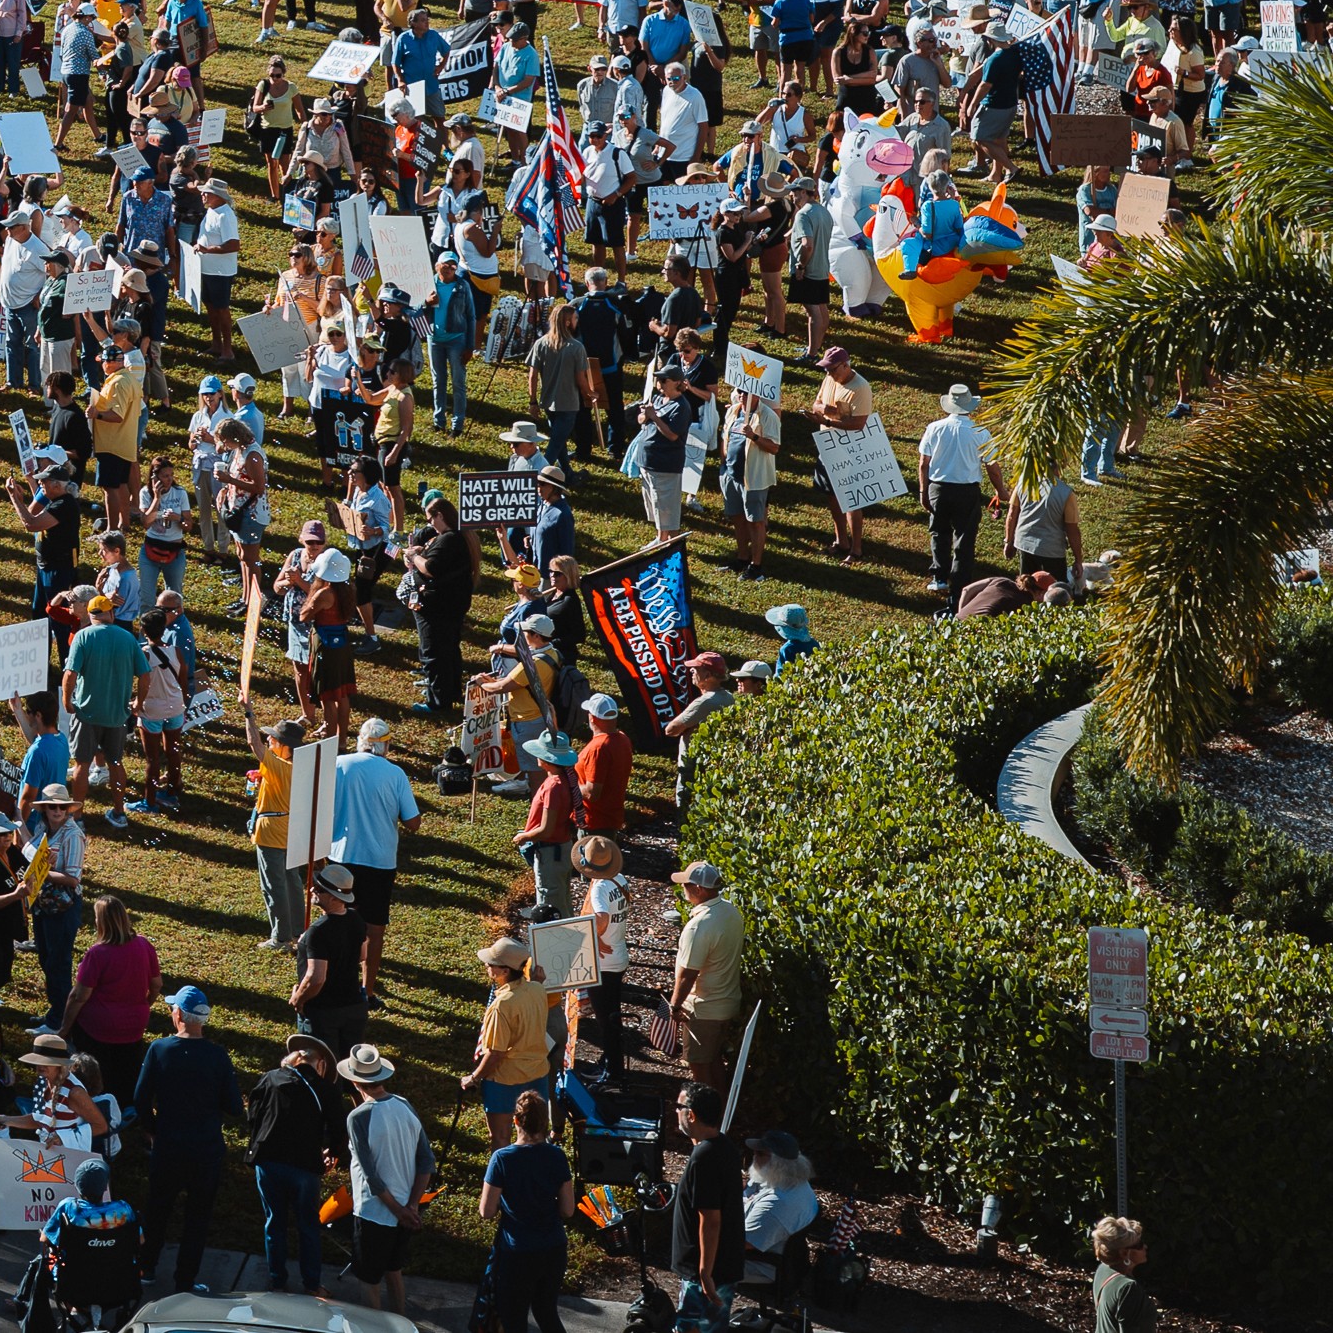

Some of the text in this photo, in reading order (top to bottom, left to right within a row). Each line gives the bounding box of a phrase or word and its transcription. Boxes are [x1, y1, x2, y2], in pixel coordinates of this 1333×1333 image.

[1262, 4, 1293, 23] NO KINGS
[940, 18, 957, 28] NO
[937, 31, 952, 41] NO
[1266, 24, 1295, 39] IMPEACH
[701, 183, 724, 194] ONLY
[1119, 213, 1140, 226] KING
[379, 229, 397, 243] NO
[651, 228, 686, 240] ORANGE
[391, 245, 413, 257] KING
[384, 263, 431, 279] IMPEACH
[77, 275, 89, 286] So
[68, 289, 84, 298] even
[73, 297, 84, 306] are
[728, 369, 777, 400] NO KINGS
[820, 416, 882, 452] HERE
[847, 443, 863, 455] I'M
[830, 448, 889, 474] THAT'S WHY
[835, 463, 894, 488] MY COUNTRY
[462, 478, 536, 493] HATE WILL
[462, 493, 536, 508] NOT MAKE
[847, 485, 886, 509] LOVE
[462, 506, 534, 522] US GREAT
[608, 585, 661, 687] ARE PISSED
[466, 710, 499, 735] CRUEL
[1104, 931, 1131, 945] PARK
[1095, 945, 1140, 960] VISITORS
[1105, 958, 1131, 972] ONLY
[1101, 977, 1144, 989] AM PM
[1094, 989, 1142, 1001] MON SUN
[1104, 1036, 1133, 1048] LOT IS
[1094, 1045, 1143, 1058] PATROLLED
[31, 1187, 55, 1203] NO
[87, 1237, 116, 1248] drive
